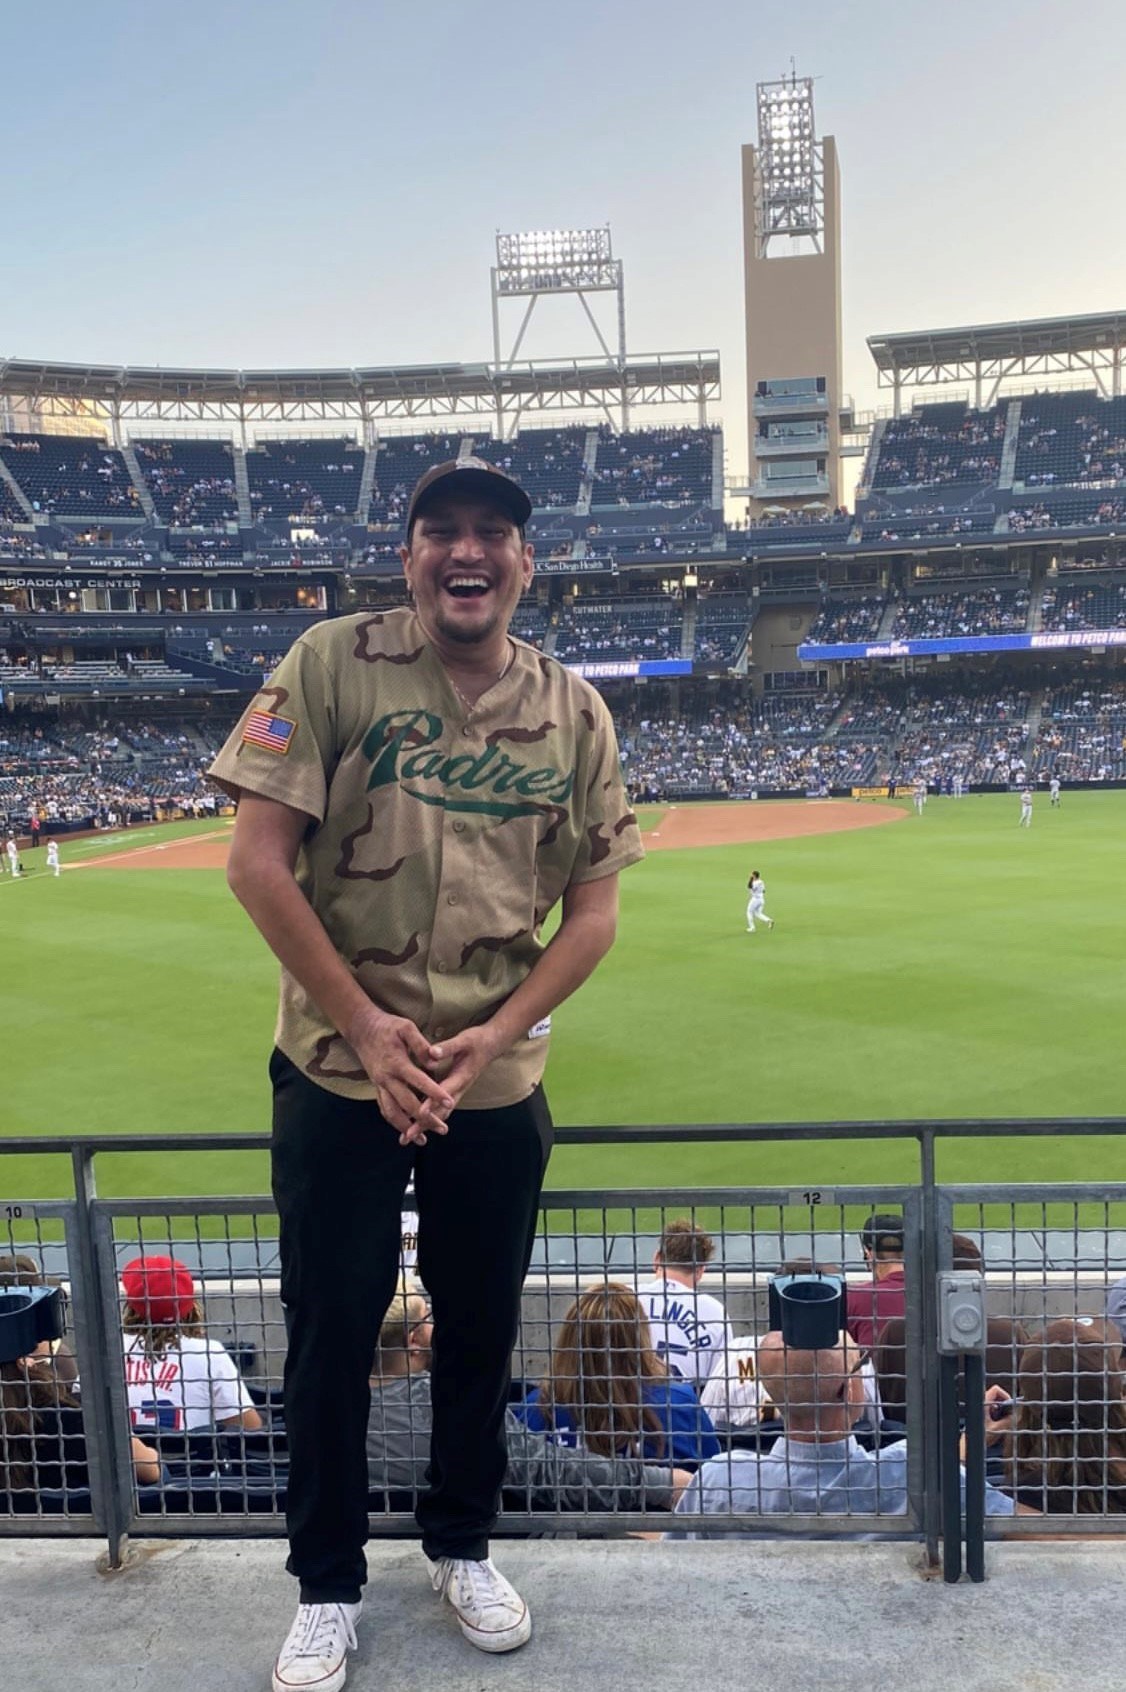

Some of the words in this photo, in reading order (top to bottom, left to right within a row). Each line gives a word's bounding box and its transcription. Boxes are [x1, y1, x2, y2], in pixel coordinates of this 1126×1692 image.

[580, 559, 603, 570] Health
[0, 578, 82, 588] BROADCAST
[87, 579, 142, 588] CENTER
[1031, 634, 1070, 646] WELCOME
[1071, 634, 1081, 645] TO
[1082, 632, 1107, 644] PETCO
[584, 665, 596, 678] TO
[596, 664, 618, 677] PETCO
[361, 709, 575, 804] Padres
[803, 1192, 821, 1205] 12
[5, 1206, 22, 1218] 10
